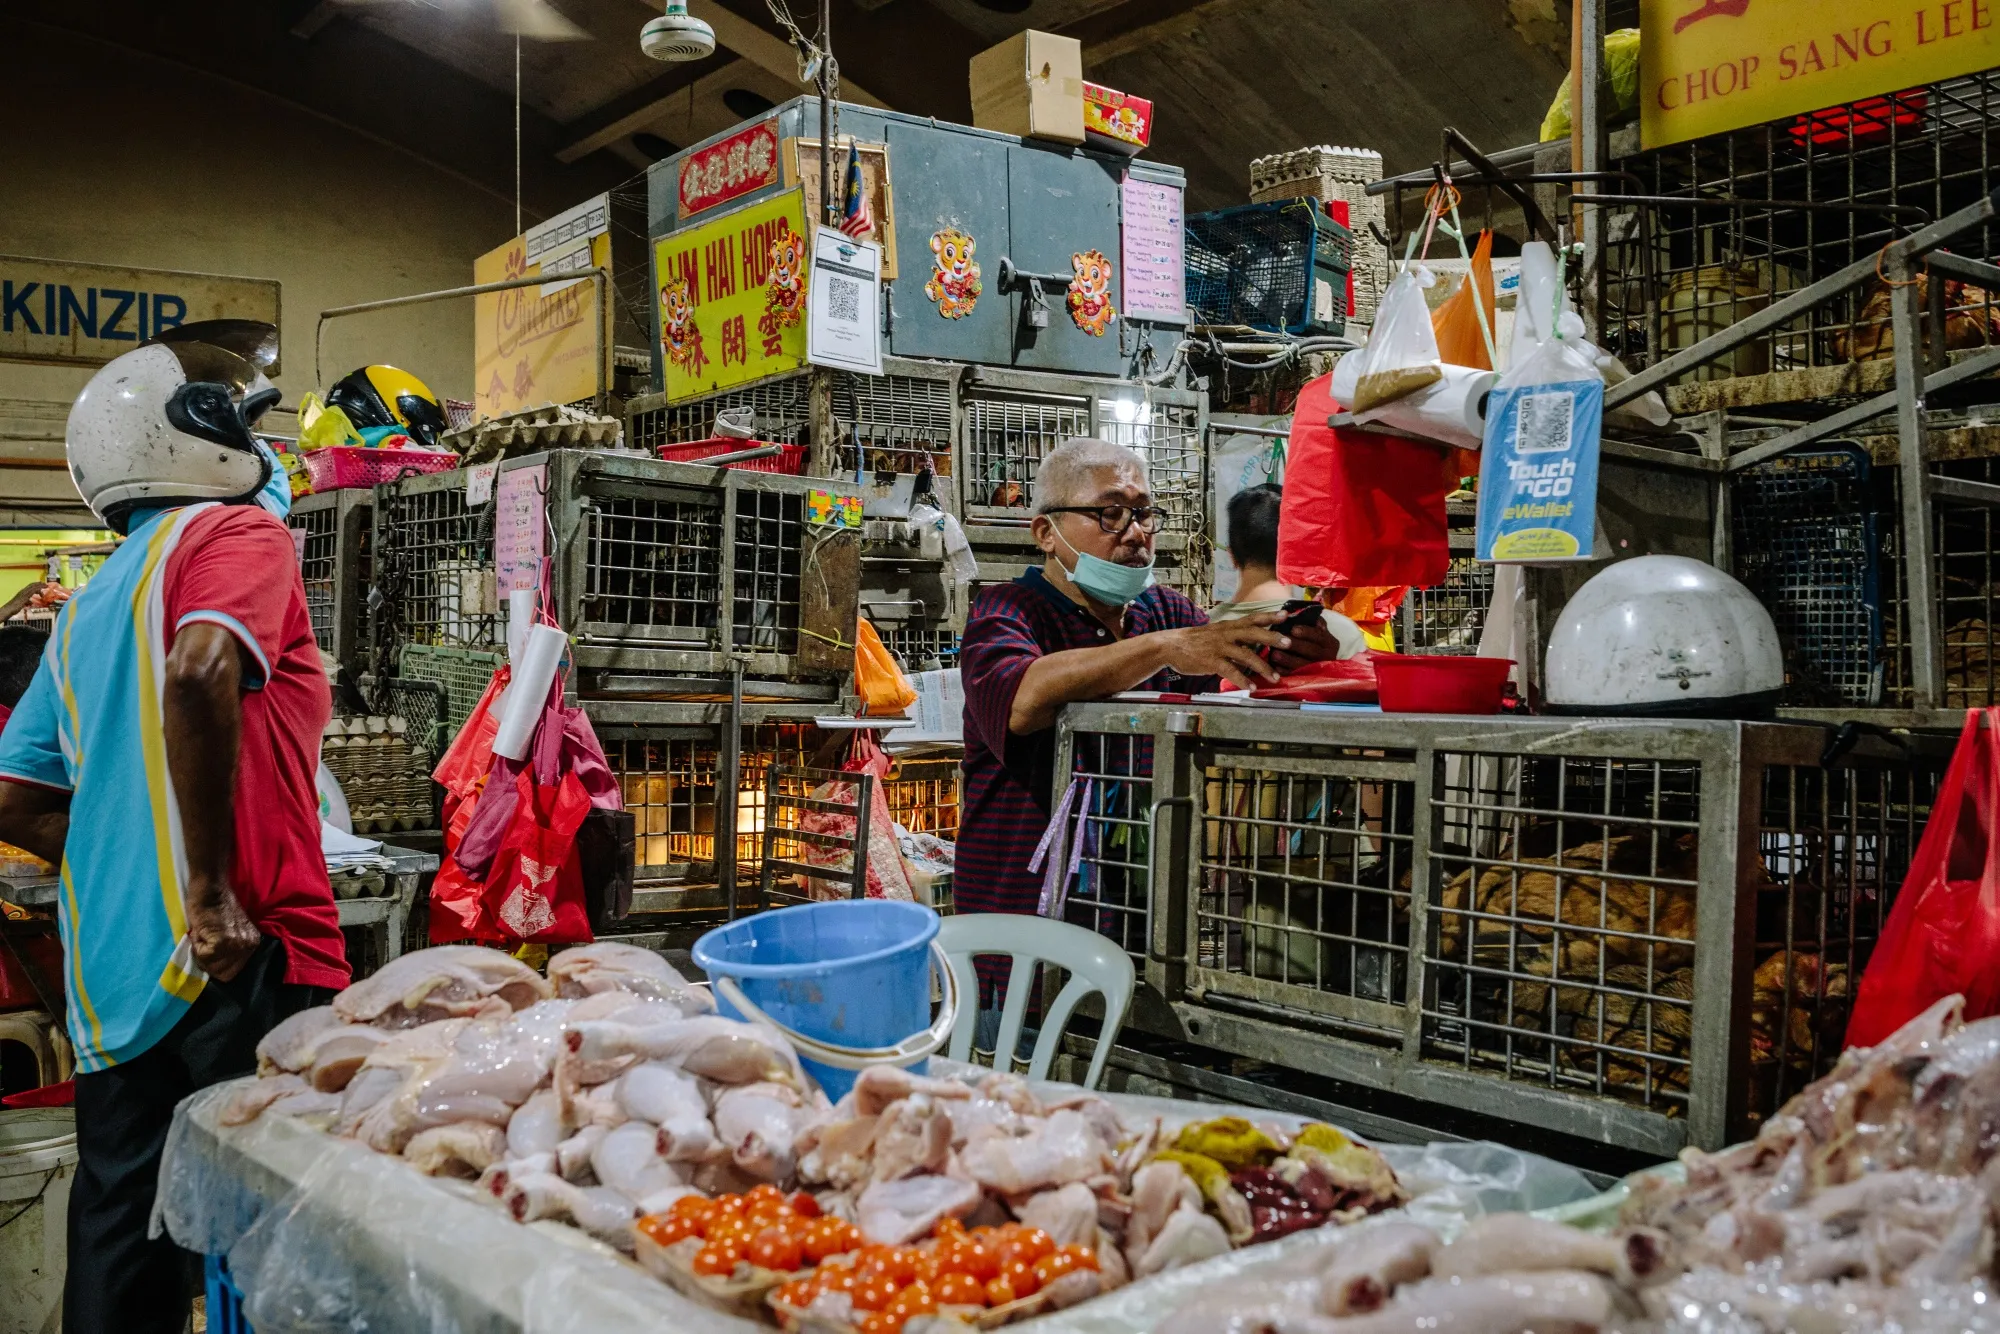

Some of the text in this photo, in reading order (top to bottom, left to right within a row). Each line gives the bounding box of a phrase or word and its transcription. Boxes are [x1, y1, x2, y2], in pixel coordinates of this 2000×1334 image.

[1657, 0, 1993, 111] CHOP SANG LEE
[705, 234, 736, 303] HAI
[3, 279, 188, 342] KINZIR
[1506, 457, 1577, 480] Touch
[1503, 501, 1573, 520] eWallet
